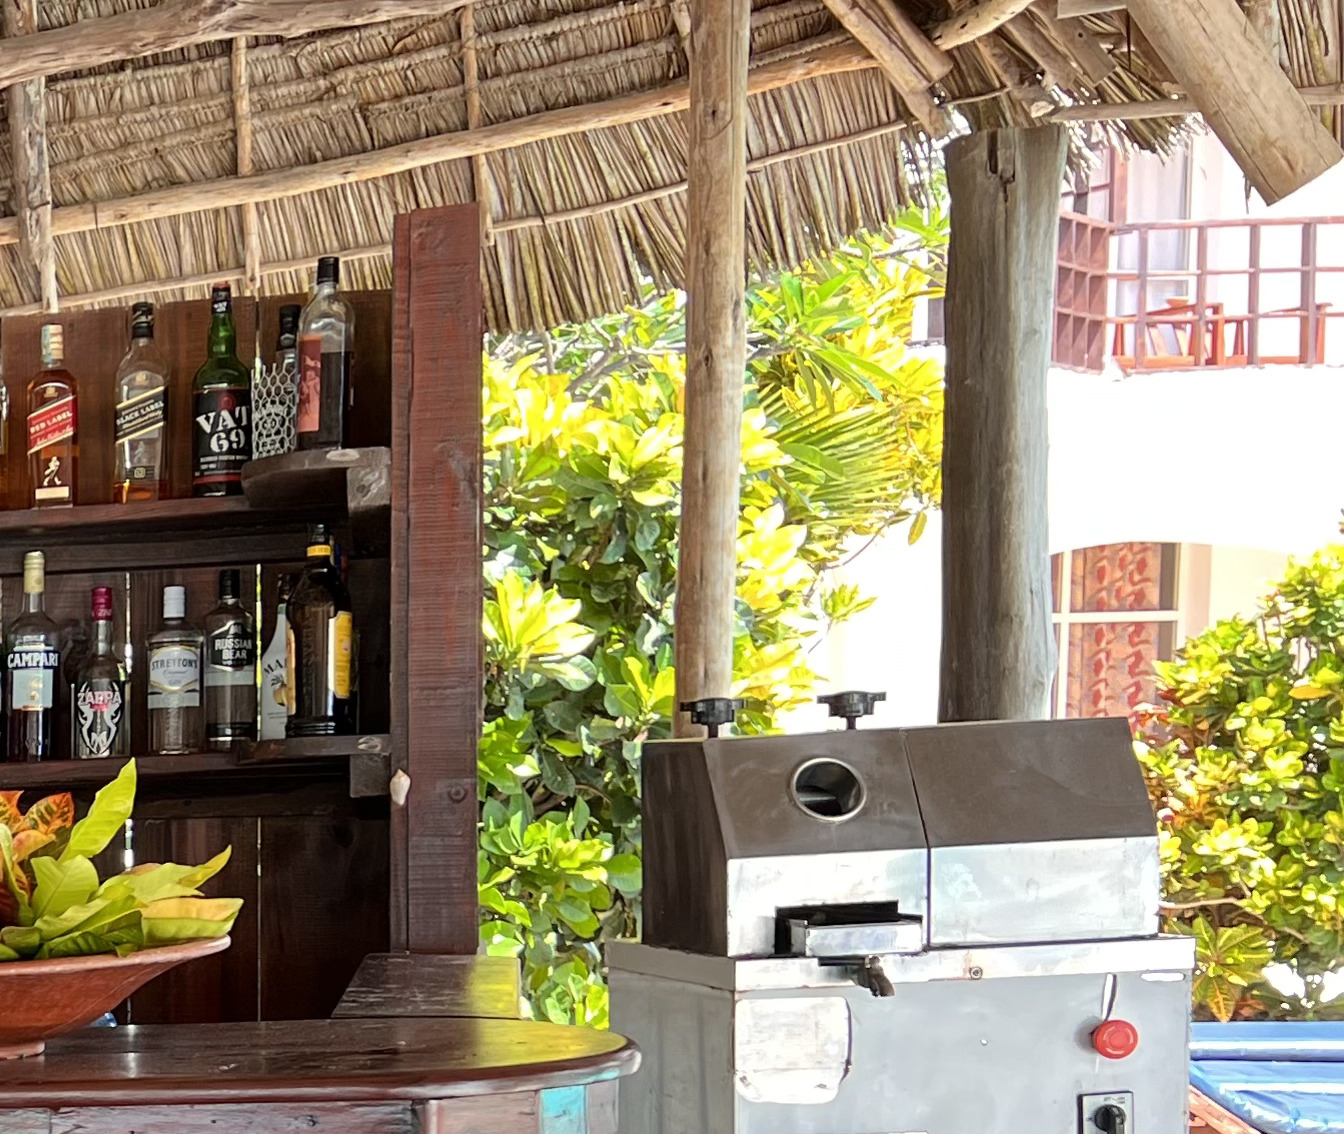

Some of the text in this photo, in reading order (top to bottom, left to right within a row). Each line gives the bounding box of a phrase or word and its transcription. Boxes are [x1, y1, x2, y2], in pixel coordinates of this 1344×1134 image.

[46, 411, 73, 426] LABEL
[116, 410, 141, 426] BLACK
[140, 400, 165, 415] LABEL
[196, 406, 250, 434] VAT
[210, 429, 246, 453] 69
[214, 638, 252, 651] RUSSIAN
[7, 652, 59, 668] CAMPARI
[222, 649, 247, 660] BEAR
[77, 691, 122, 705] ZAPPA
